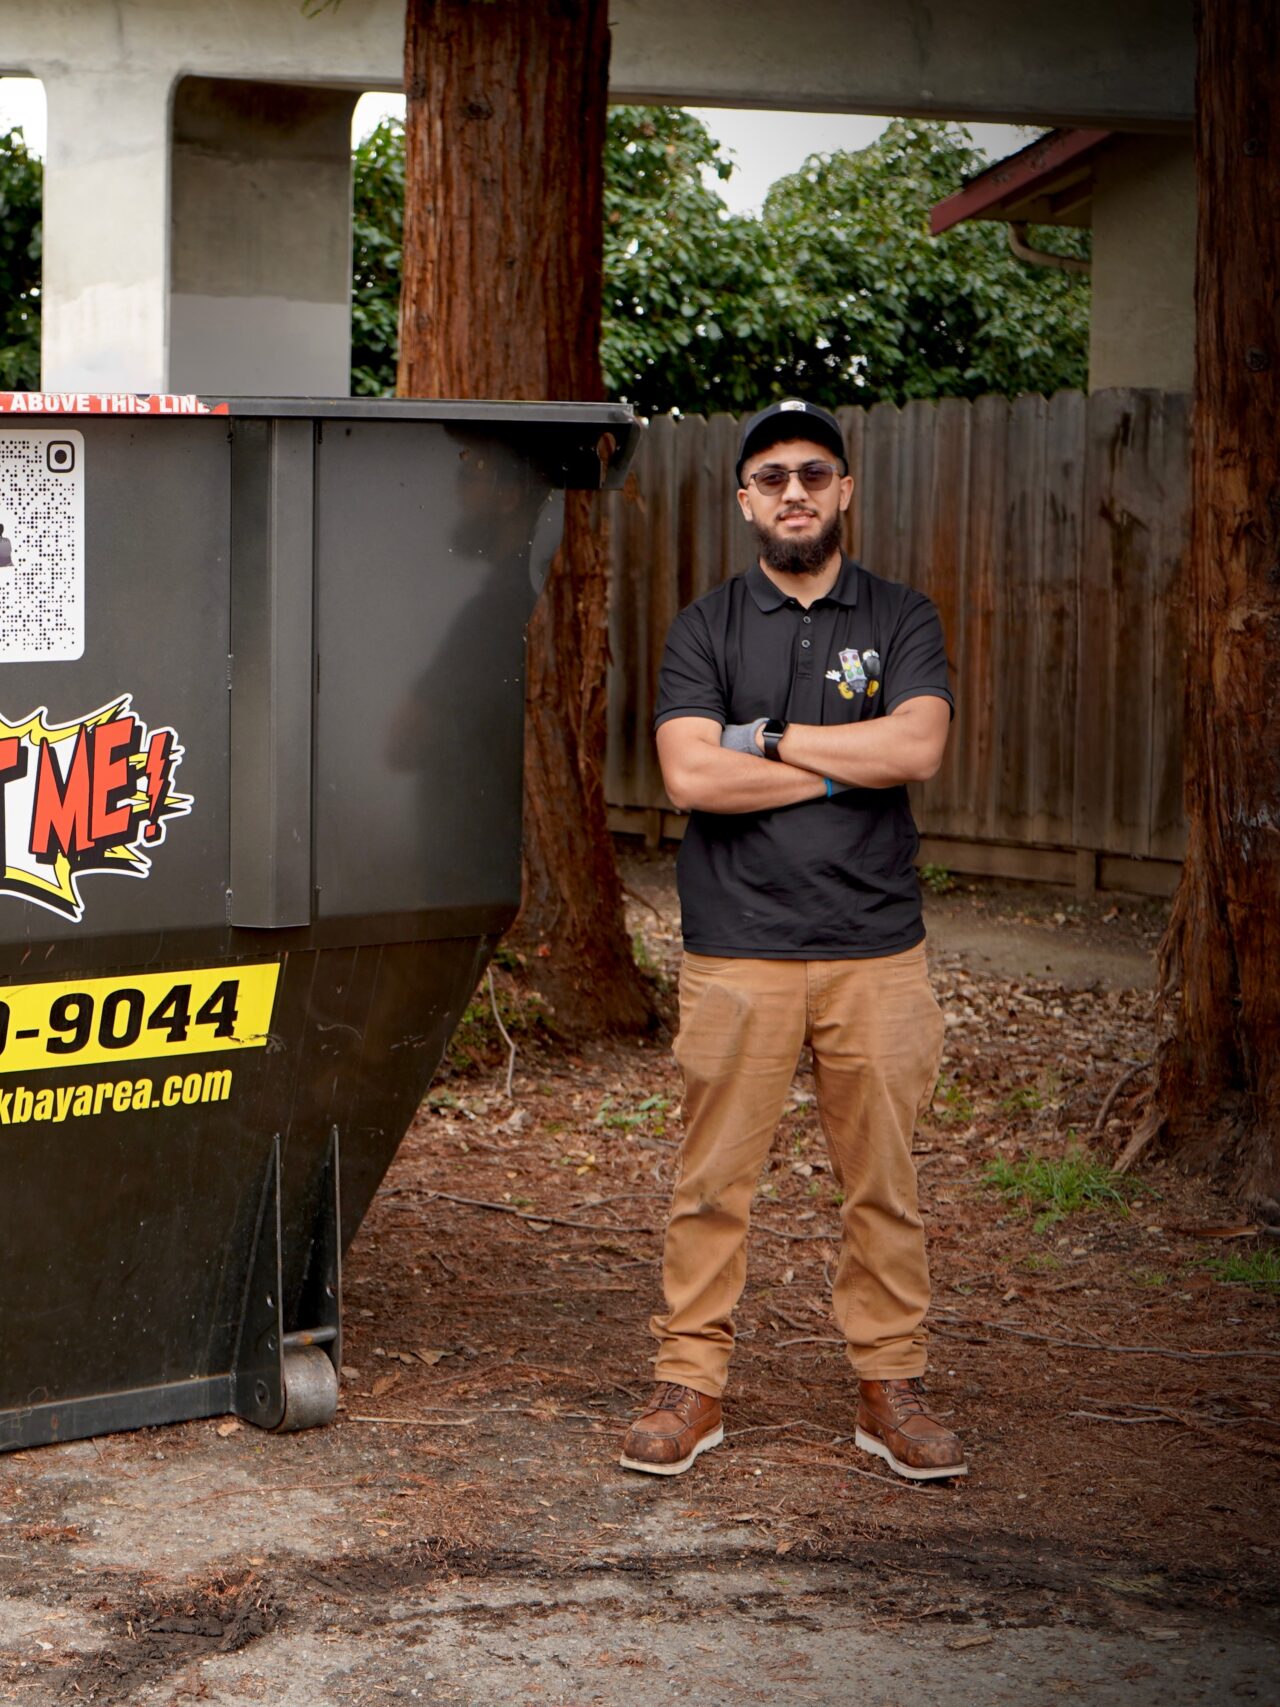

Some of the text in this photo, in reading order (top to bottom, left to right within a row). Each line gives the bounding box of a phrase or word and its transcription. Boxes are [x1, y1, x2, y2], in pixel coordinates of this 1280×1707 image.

[10, 393, 90, 413] ABOVE
[96, 394, 151, 413] THIS
[31, 716, 171, 857] ME!
